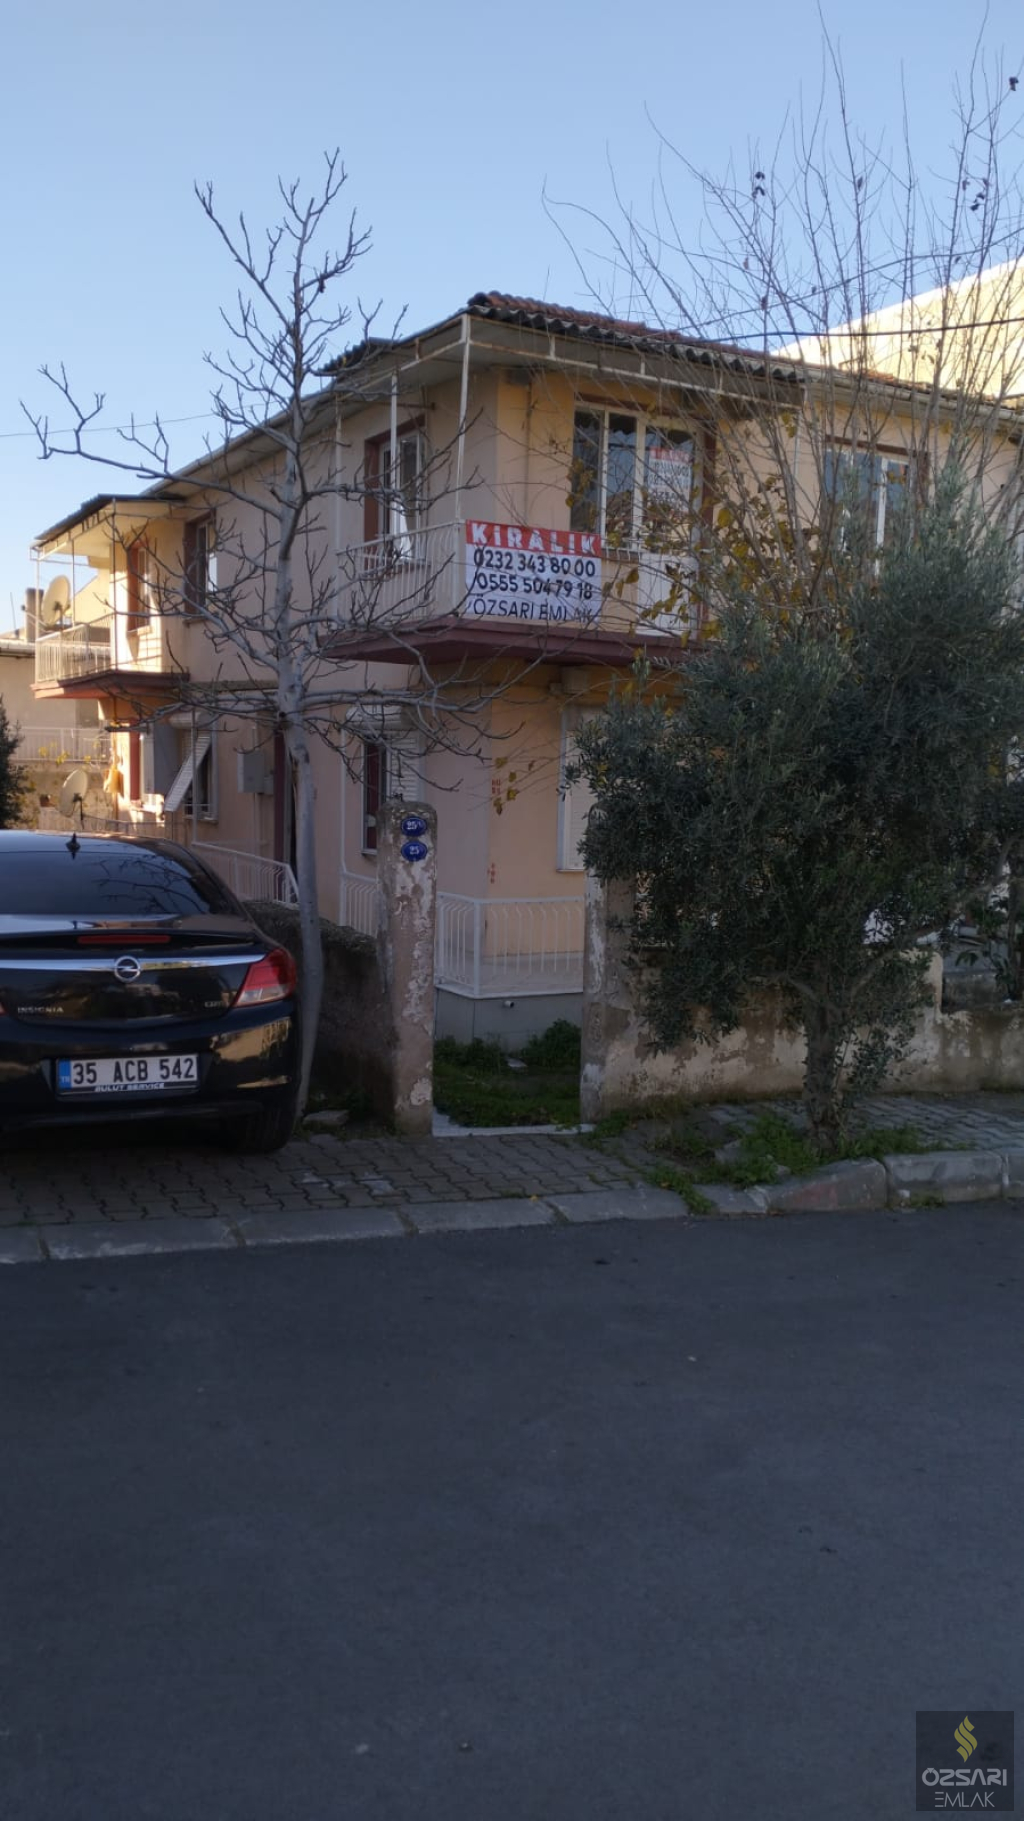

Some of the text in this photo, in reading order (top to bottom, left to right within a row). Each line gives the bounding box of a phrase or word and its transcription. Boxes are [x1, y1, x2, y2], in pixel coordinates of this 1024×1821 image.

[473, 549, 596, 577] 0232 343 80 00
[476, 572, 593, 600] 0555 504 79 18
[473, 594, 534, 620] ÖZSARI
[73, 1057, 195, 1085] 35 ACB 542
